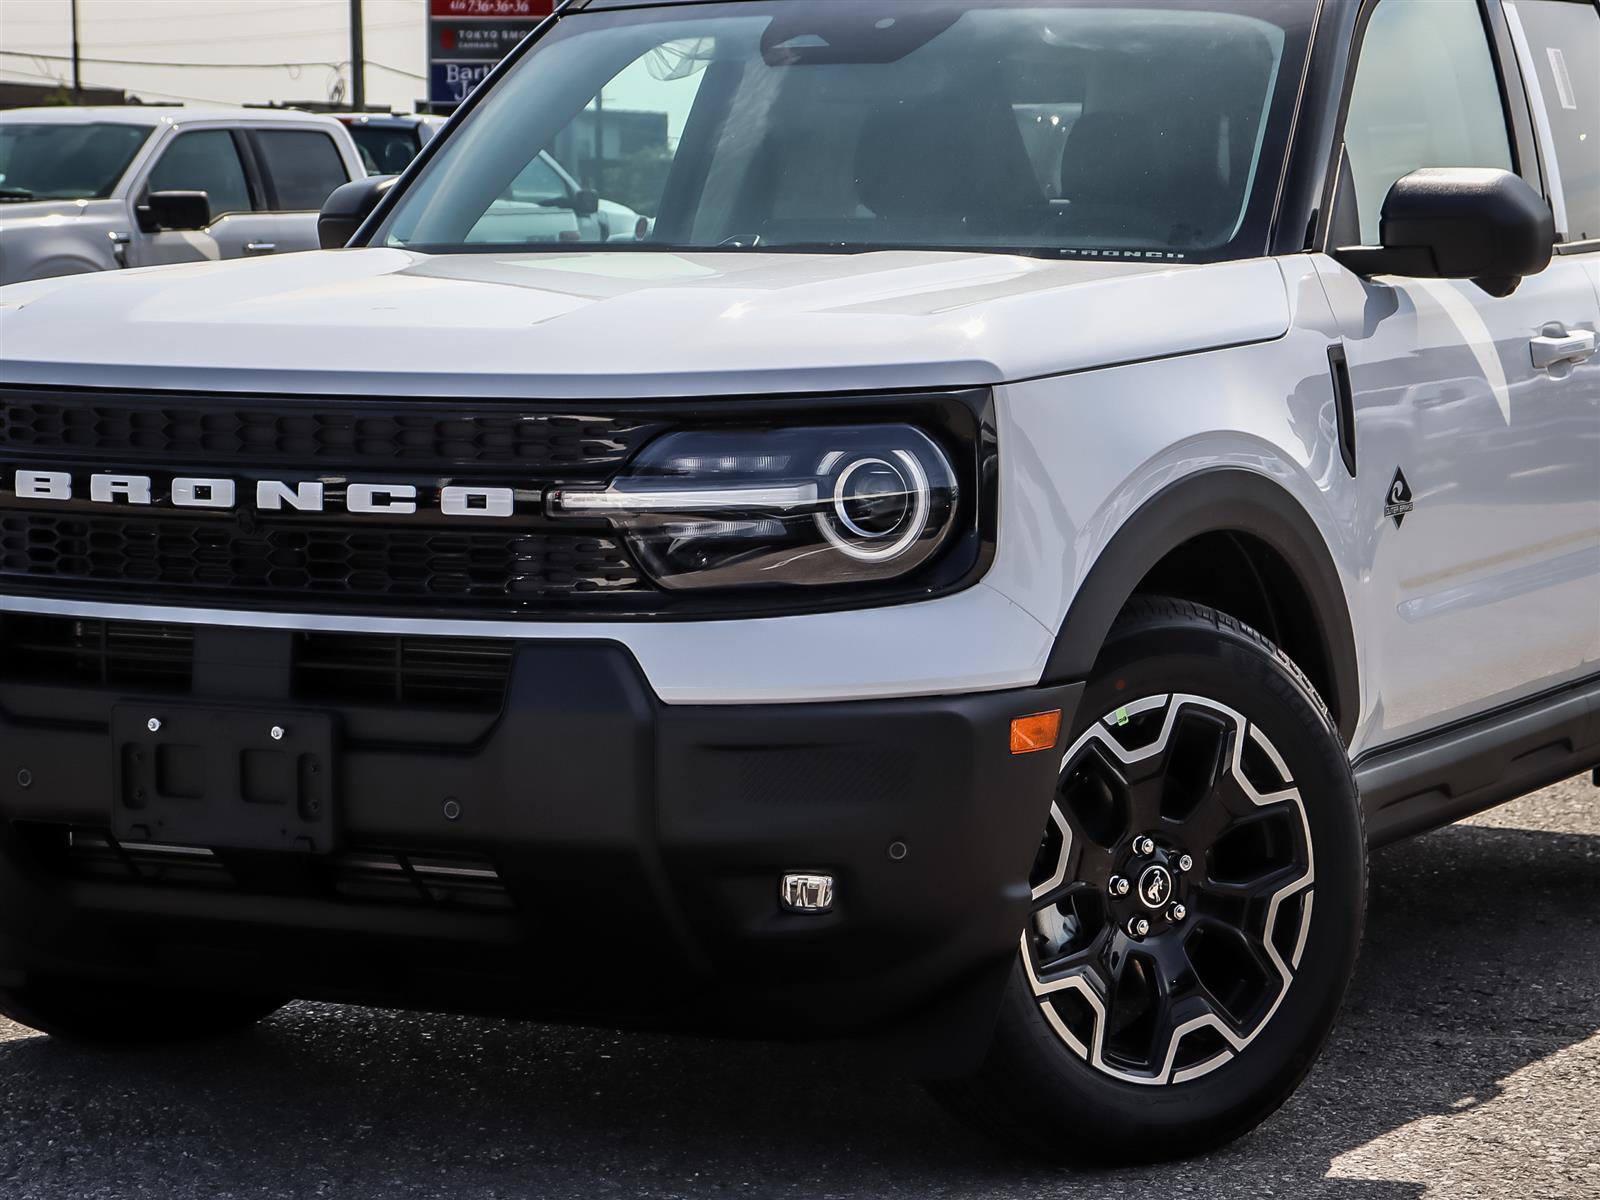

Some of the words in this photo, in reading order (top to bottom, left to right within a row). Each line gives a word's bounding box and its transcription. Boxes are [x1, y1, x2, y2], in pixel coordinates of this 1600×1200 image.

[458, 30, 498, 39] TOKYO
[446, 64, 497, 83] Bart
[15, 470, 514, 517] BRONCO
